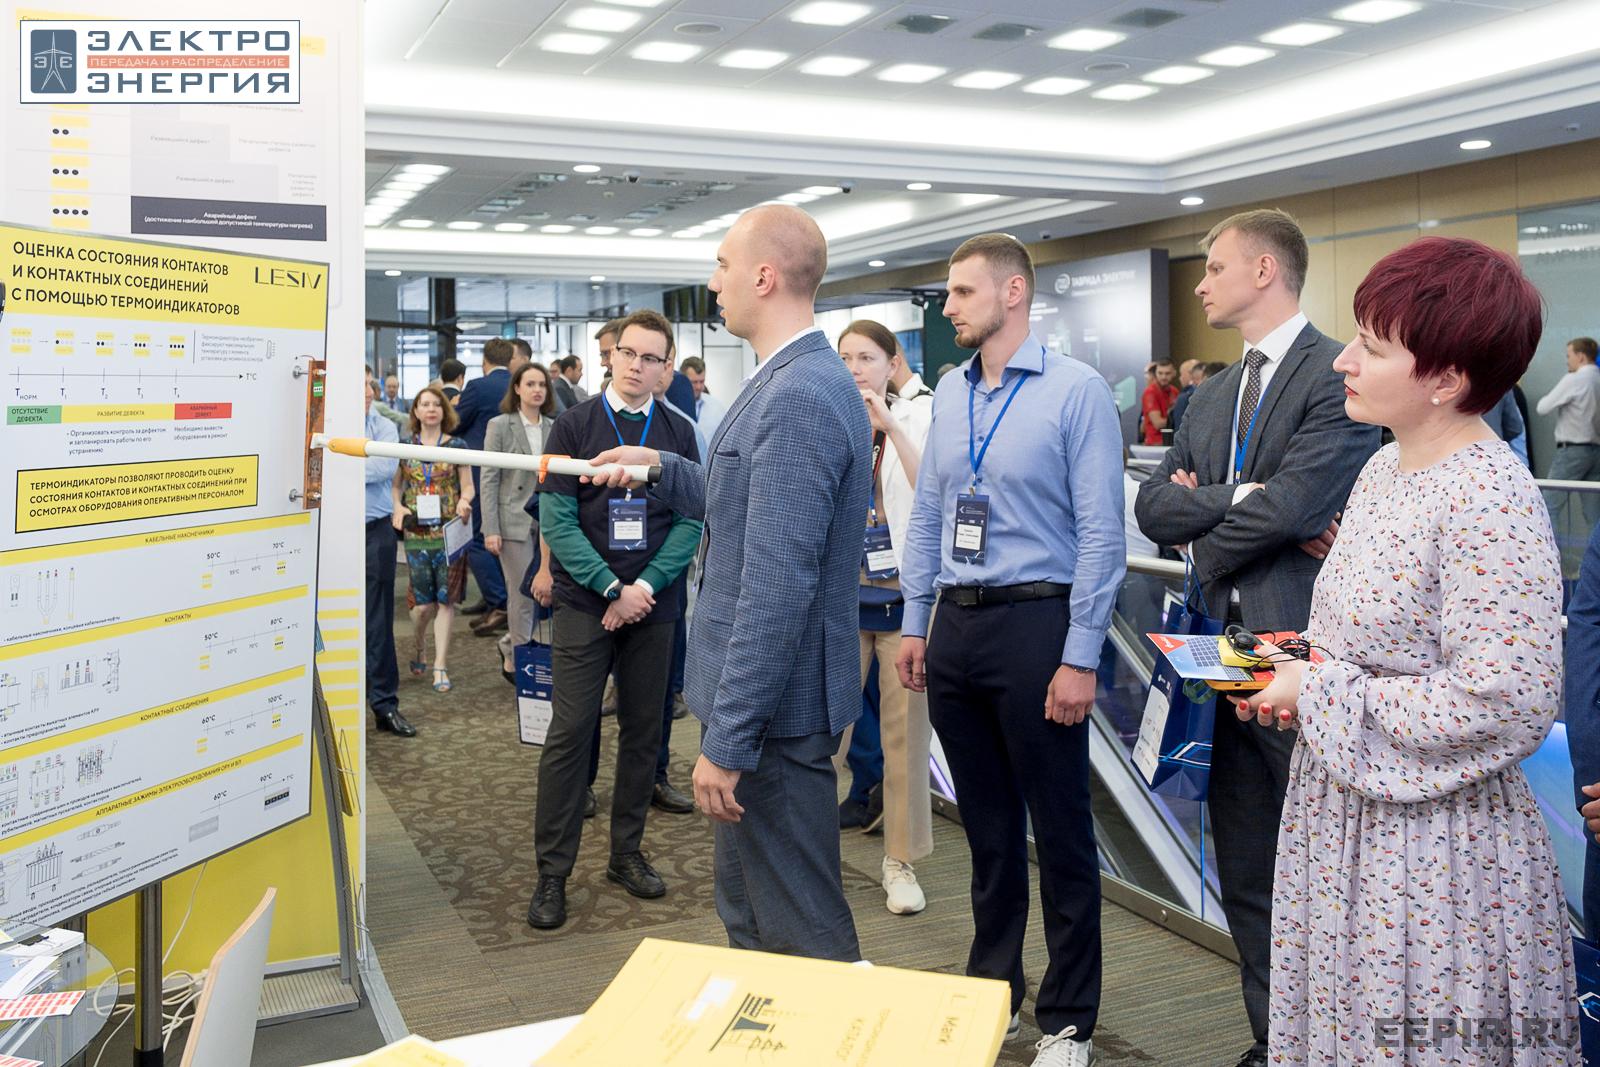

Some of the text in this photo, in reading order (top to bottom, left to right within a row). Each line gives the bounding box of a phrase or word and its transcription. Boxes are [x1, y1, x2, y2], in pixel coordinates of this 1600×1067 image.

[13, 241, 229, 276] ОЦЕНКА СОСТОЯНИЯ КОНТАКТОВ
[12, 265, 209, 294] И КОНТАКТНЫХ СОЕДИНЕНИЙ
[254, 266, 322, 289] LESIV
[12, 288, 240, 316] С ПОМОЩЬЮ ТЕРМОИНДИКАТОРОВ
[12, 408, 48, 416] ОТСУТСТВИЕ
[70, 428, 110, 438] Организовать
[110, 428, 135, 436] контроль
[74, 438, 115, 446] запланировать
[116, 436, 135, 444] работы
[69, 448, 104, 456] устранению
[30, 467, 234, 491] ТЕРМОИНДИКАТОРЫ ПОЗВОЛЯЮТ ПРОВОДИТЬ ОЦЕНКУ
[30, 492, 83, 504] СОСТОЯНИЯ
[84, 488, 130, 498] КОНТАКТОВ
[138, 482, 186, 493] КОНТАКТНЫХ
[186, 477, 233, 490] СОЕДИНЕНИЙ
[234, 477, 248, 485] ПРИ
[29, 488, 244, 518] ОСМОТРАХ ОБОРУДОВАНИЯ ОПЕРАТИВНЫМ ПЕРСОНАЛОМ
[145, 528, 215, 544] КАБЕЛЬНЫЕ НАКОНЕЧНИКИ
[206, 552, 221, 560] 50°C
[164, 613, 192, 623] КОНТАКТЫ
[204, 632, 218, 641] 50°C
[140, 697, 209, 722] КОНТАКТНЫЕ СОЕДИНЕНИЯ
[201, 714, 216, 725] 60°C
[95, 800, 134, 817] АППАРАТНЫЕ
[134, 790, 158, 804] ЗАЖИМЫ
